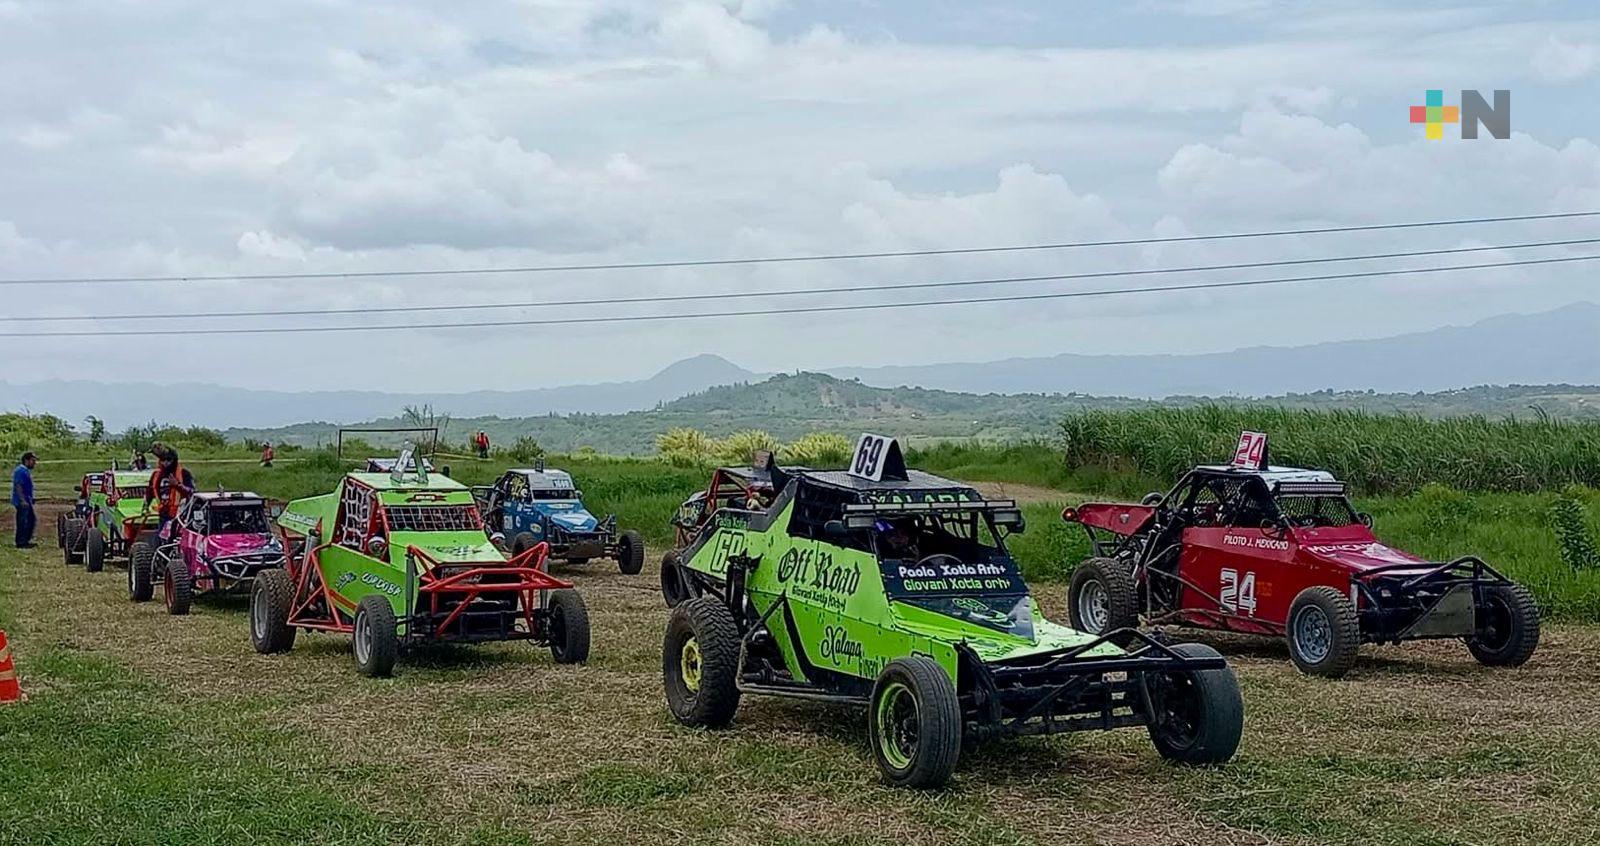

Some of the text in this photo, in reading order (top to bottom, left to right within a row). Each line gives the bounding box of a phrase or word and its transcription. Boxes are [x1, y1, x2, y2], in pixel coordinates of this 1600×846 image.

[854, 435, 884, 477] 69
[1235, 434, 1264, 467] 24
[1223, 535, 1247, 546] PILOTO
[1255, 538, 1289, 550] MEXICANO
[777, 547, 861, 596] Off Road
[899, 566, 936, 578] Paola
[940, 564, 976, 576] Xotla
[903, 579, 948, 591] Giovani
[948, 577, 982, 590] Xotla
[1220, 567, 1257, 618] 24
[821, 626, 862, 666] Xalapa
